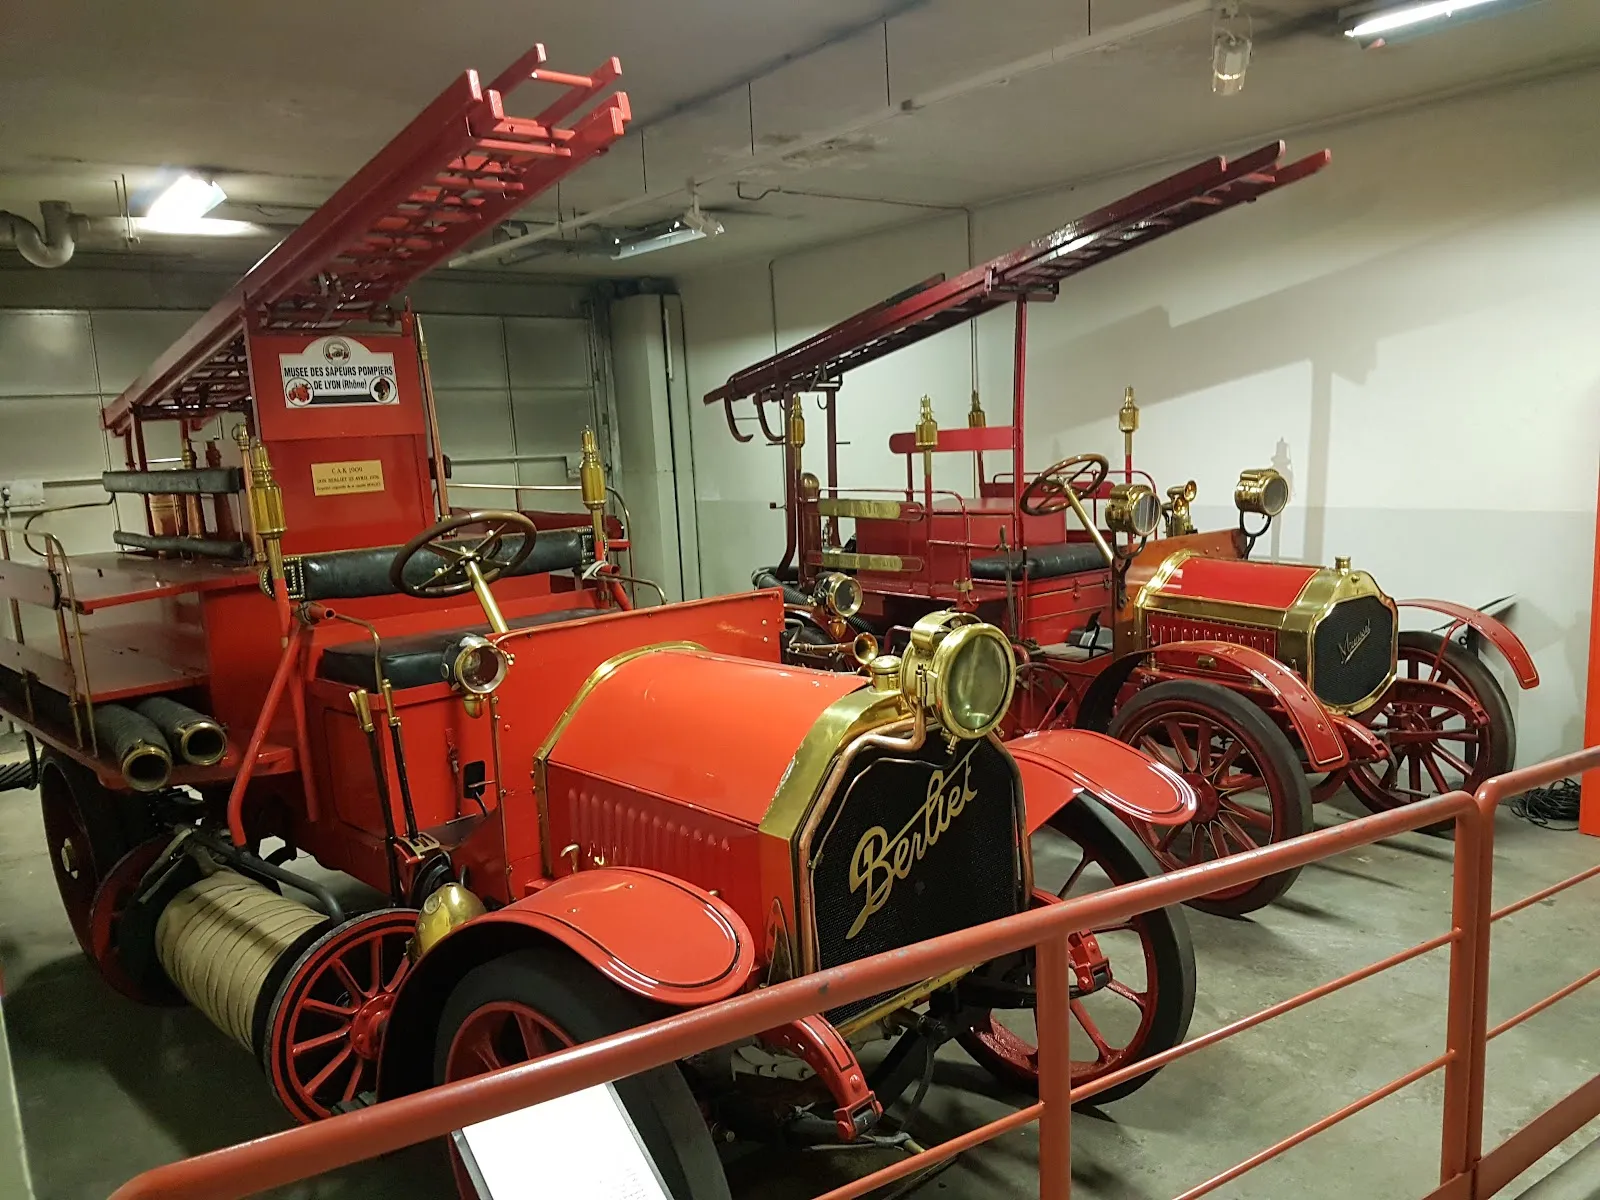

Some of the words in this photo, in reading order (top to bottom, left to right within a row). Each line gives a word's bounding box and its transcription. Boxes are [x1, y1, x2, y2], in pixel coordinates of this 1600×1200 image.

[284, 367, 308, 377] MUSEE
[311, 367, 324, 377] DES
[326, 366, 356, 376] SAPEURS
[358, 366, 393, 376] POMPIERS
[314, 381, 322, 390] DE
[324, 380, 341, 390] LYON
[342, 379, 367, 390] (Rhône)
[845, 740, 979, 940] Berliet
